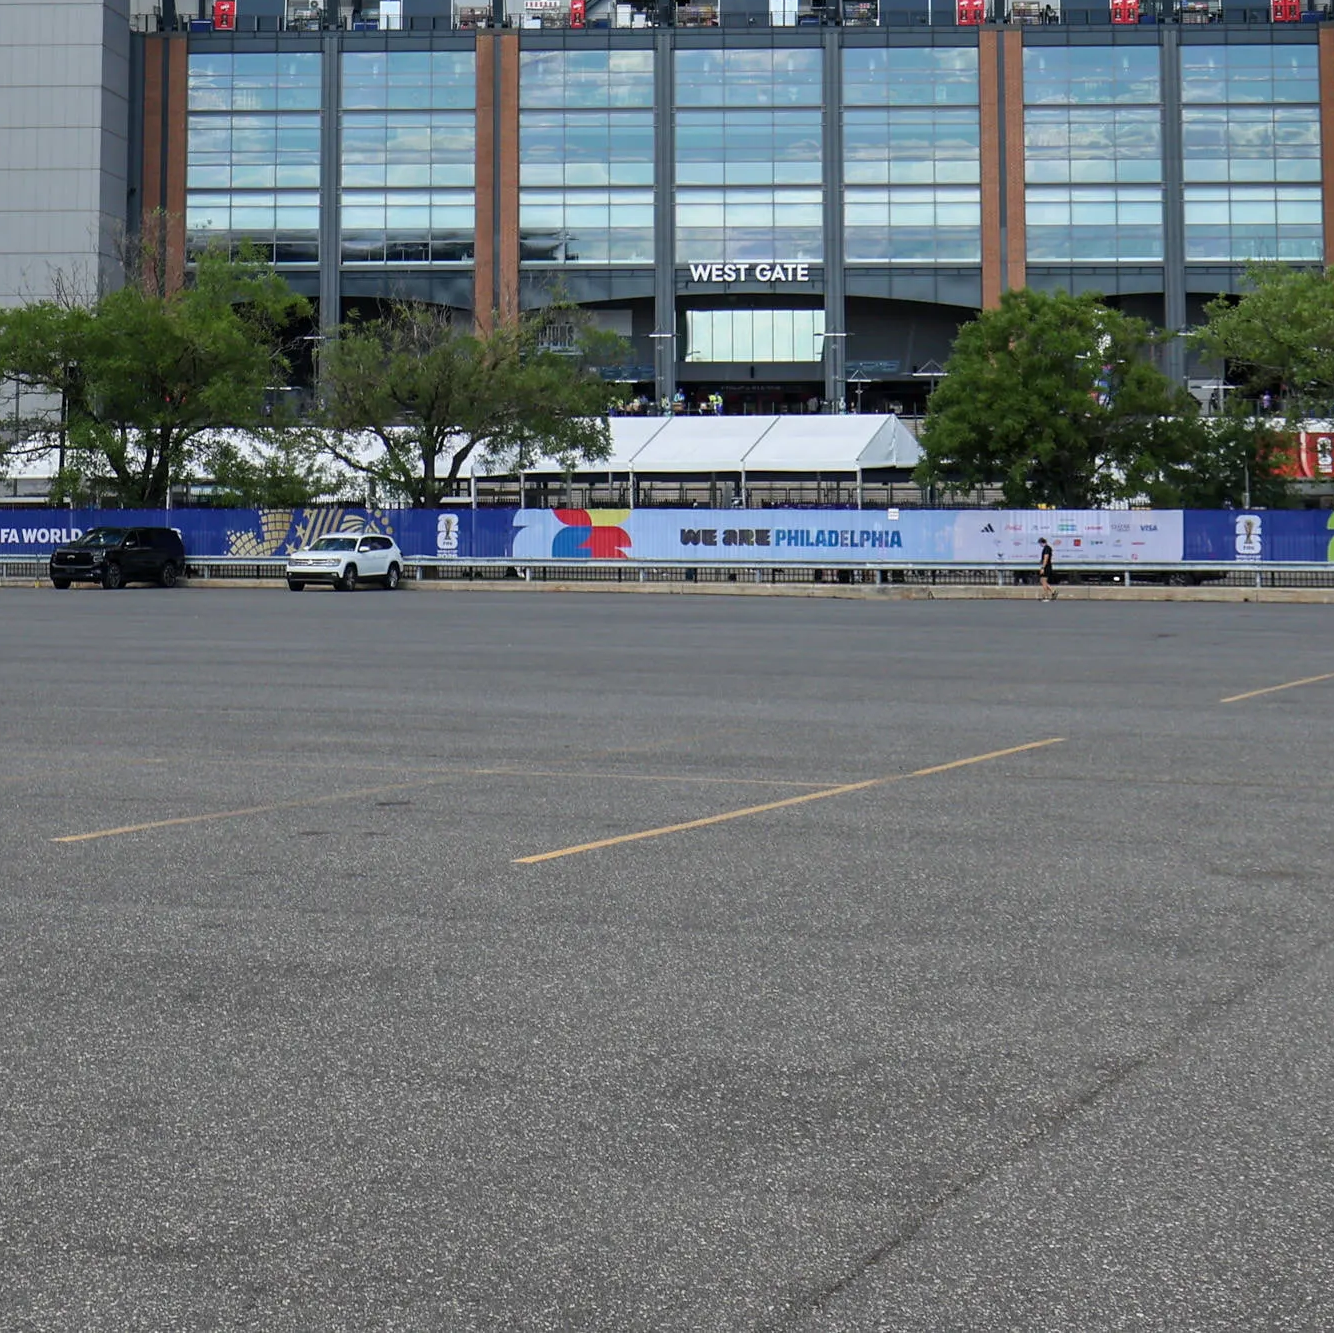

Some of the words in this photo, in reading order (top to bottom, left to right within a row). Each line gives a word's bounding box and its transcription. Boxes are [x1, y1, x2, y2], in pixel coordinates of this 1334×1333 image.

[690, 263, 749, 282] WEST
[755, 263, 809, 282] GATE
[22, 528, 83, 544] WORLD
[680, 528, 718, 546] WE
[774, 529, 903, 548] PHILADELPHIA
